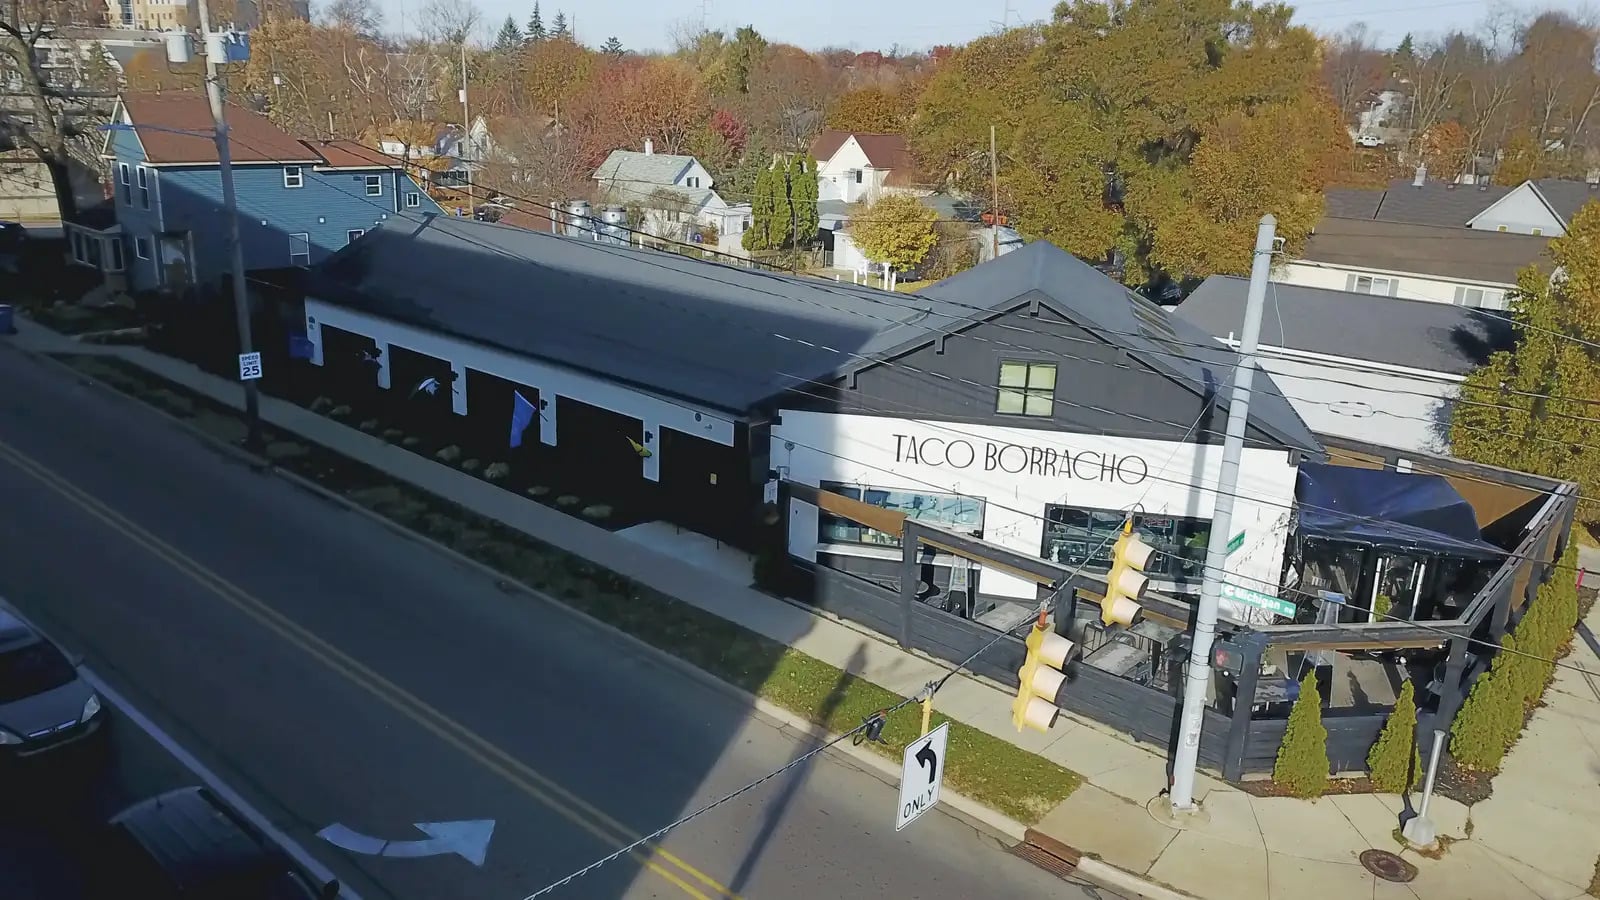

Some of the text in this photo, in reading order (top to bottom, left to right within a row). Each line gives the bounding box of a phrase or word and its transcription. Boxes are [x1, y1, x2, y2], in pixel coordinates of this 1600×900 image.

[243, 365, 259, 376] 25
[892, 433, 1148, 485] TACO BORRACHO
[1235, 586, 1281, 610] Michigan
[904, 786, 934, 818] ONLY
